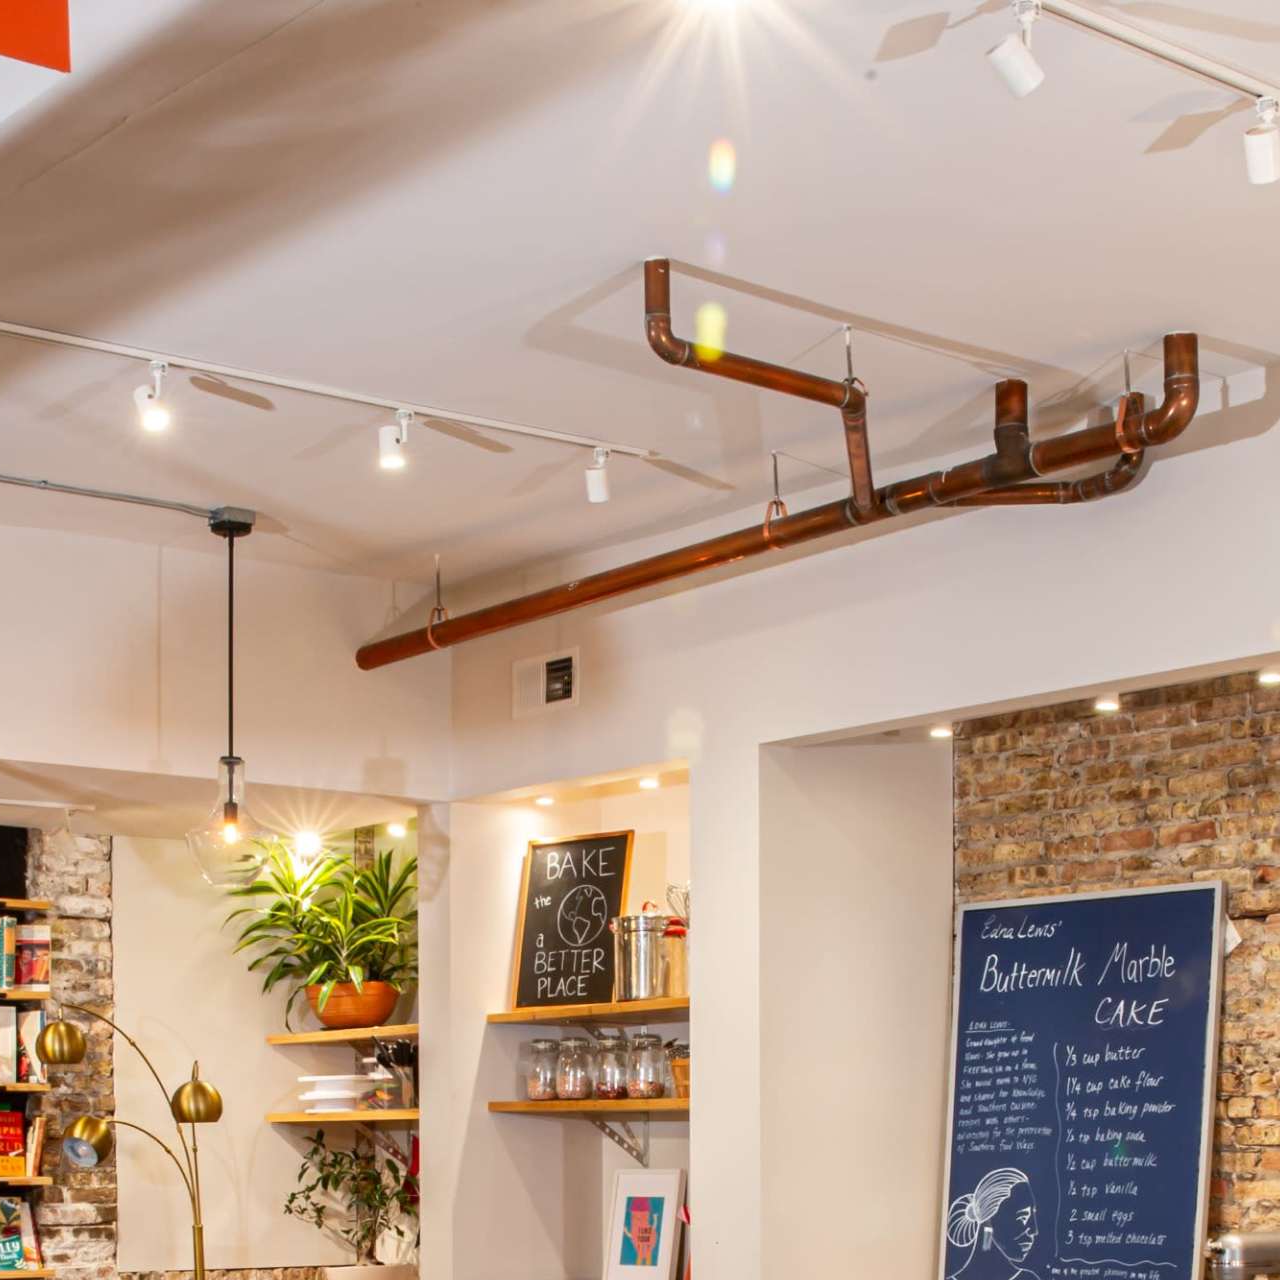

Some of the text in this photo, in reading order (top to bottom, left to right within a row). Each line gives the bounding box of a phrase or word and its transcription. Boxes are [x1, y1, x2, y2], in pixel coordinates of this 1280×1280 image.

[547, 847, 616, 880] BAKE
[533, 896, 552, 909] the
[981, 914, 1015, 940] Edna
[536, 934, 544, 948] a
[534, 948, 605, 975] BETTER
[980, 942, 1176, 993] Buttermilk Marble
[537, 975, 590, 999] PLACE
[1095, 997, 1169, 1028] CAKE
[1083, 1053, 1100, 1067] cup
[1104, 1043, 1146, 1062] butter
[1086, 1081, 1103, 1094] cup
[1108, 1075, 1131, 1090] cake
[1083, 1107, 1099, 1120] tsp
[1104, 1100, 1138, 1121] baking
[1095, 1126, 1122, 1147] baking
[1080, 1158, 1097, 1172] cup
[1103, 1152, 1157, 1168] buttermilk
[1080, 1184, 1098, 1198] tsp
[1105, 1181, 1138, 1196] vanilla
[1069, 1208, 1134, 1228] 2 small eggs
[1065, 1230, 1073, 1244] 3
[1078, 1233, 1092, 1247] tsp
[1095, 1232, 1122, 1244] melted
